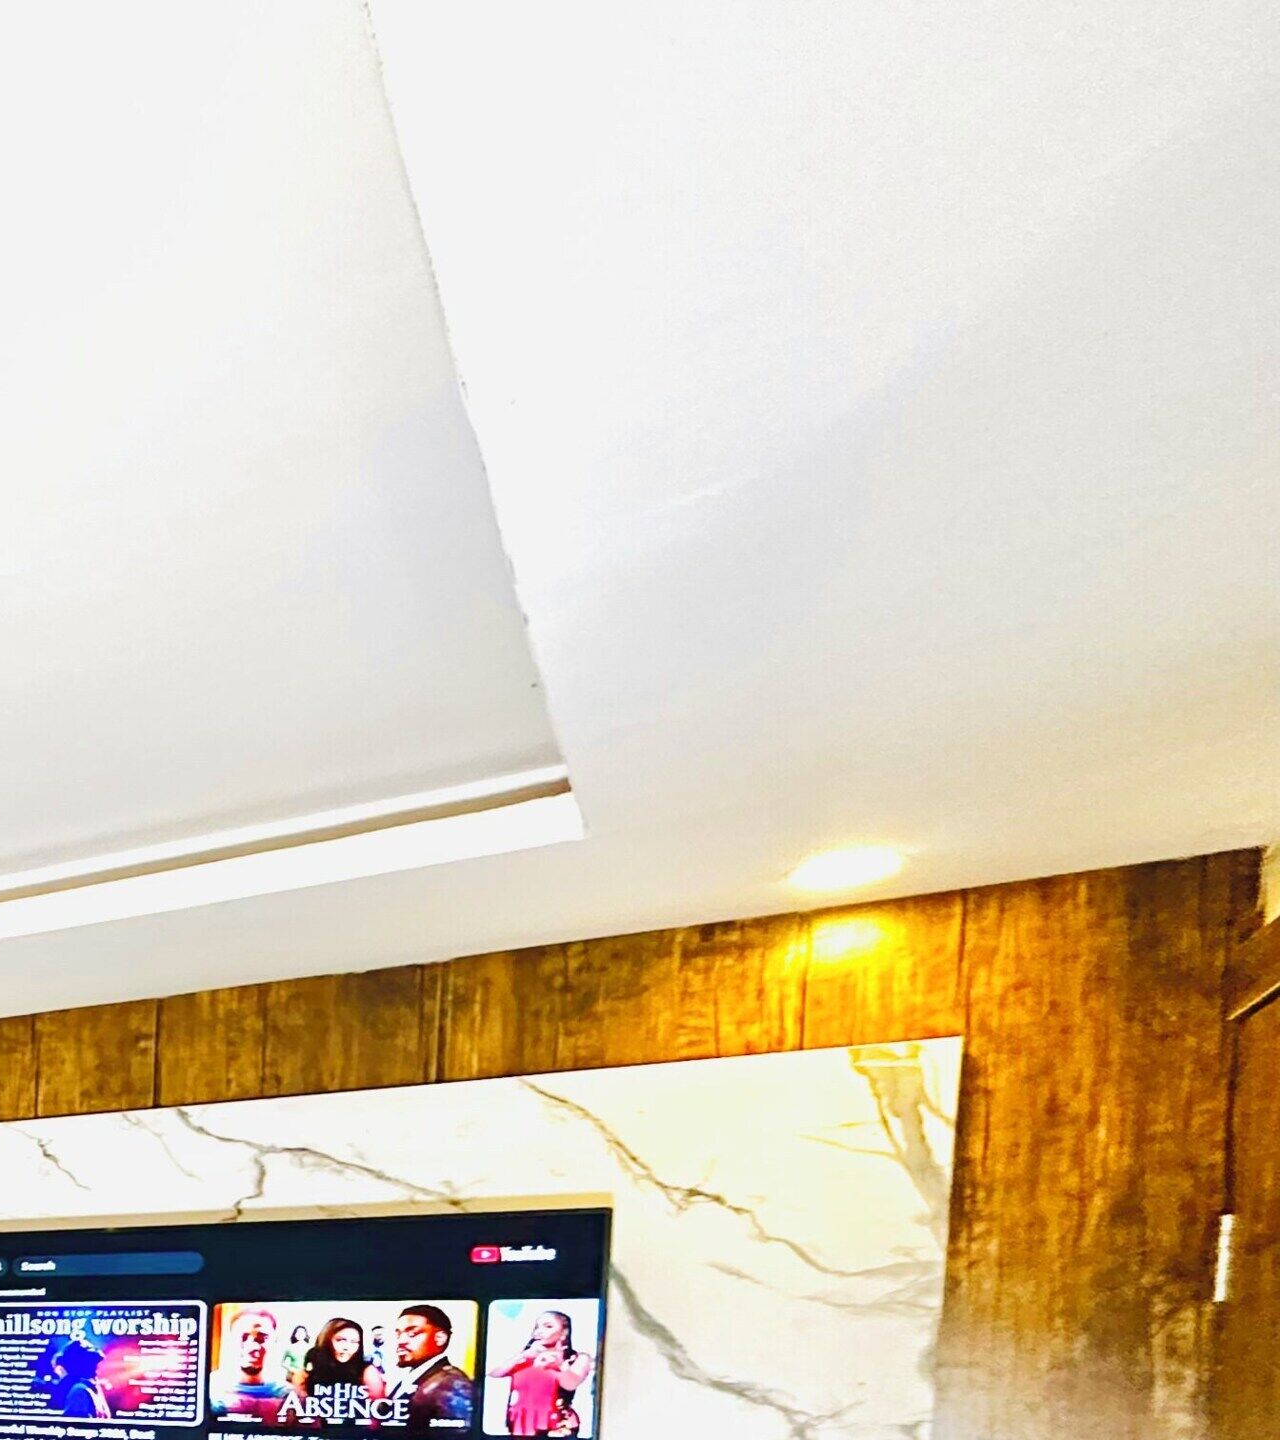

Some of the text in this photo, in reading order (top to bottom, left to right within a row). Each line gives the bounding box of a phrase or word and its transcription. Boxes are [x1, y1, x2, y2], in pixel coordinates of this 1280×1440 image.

[20, 1260, 56, 1272] Search
[96, 1309, 151, 1318] PLAYLIST
[90, 1312, 197, 1341] worship
[313, 1382, 369, 1400] IN HIS
[277, 1391, 411, 1420] ABSENCE
